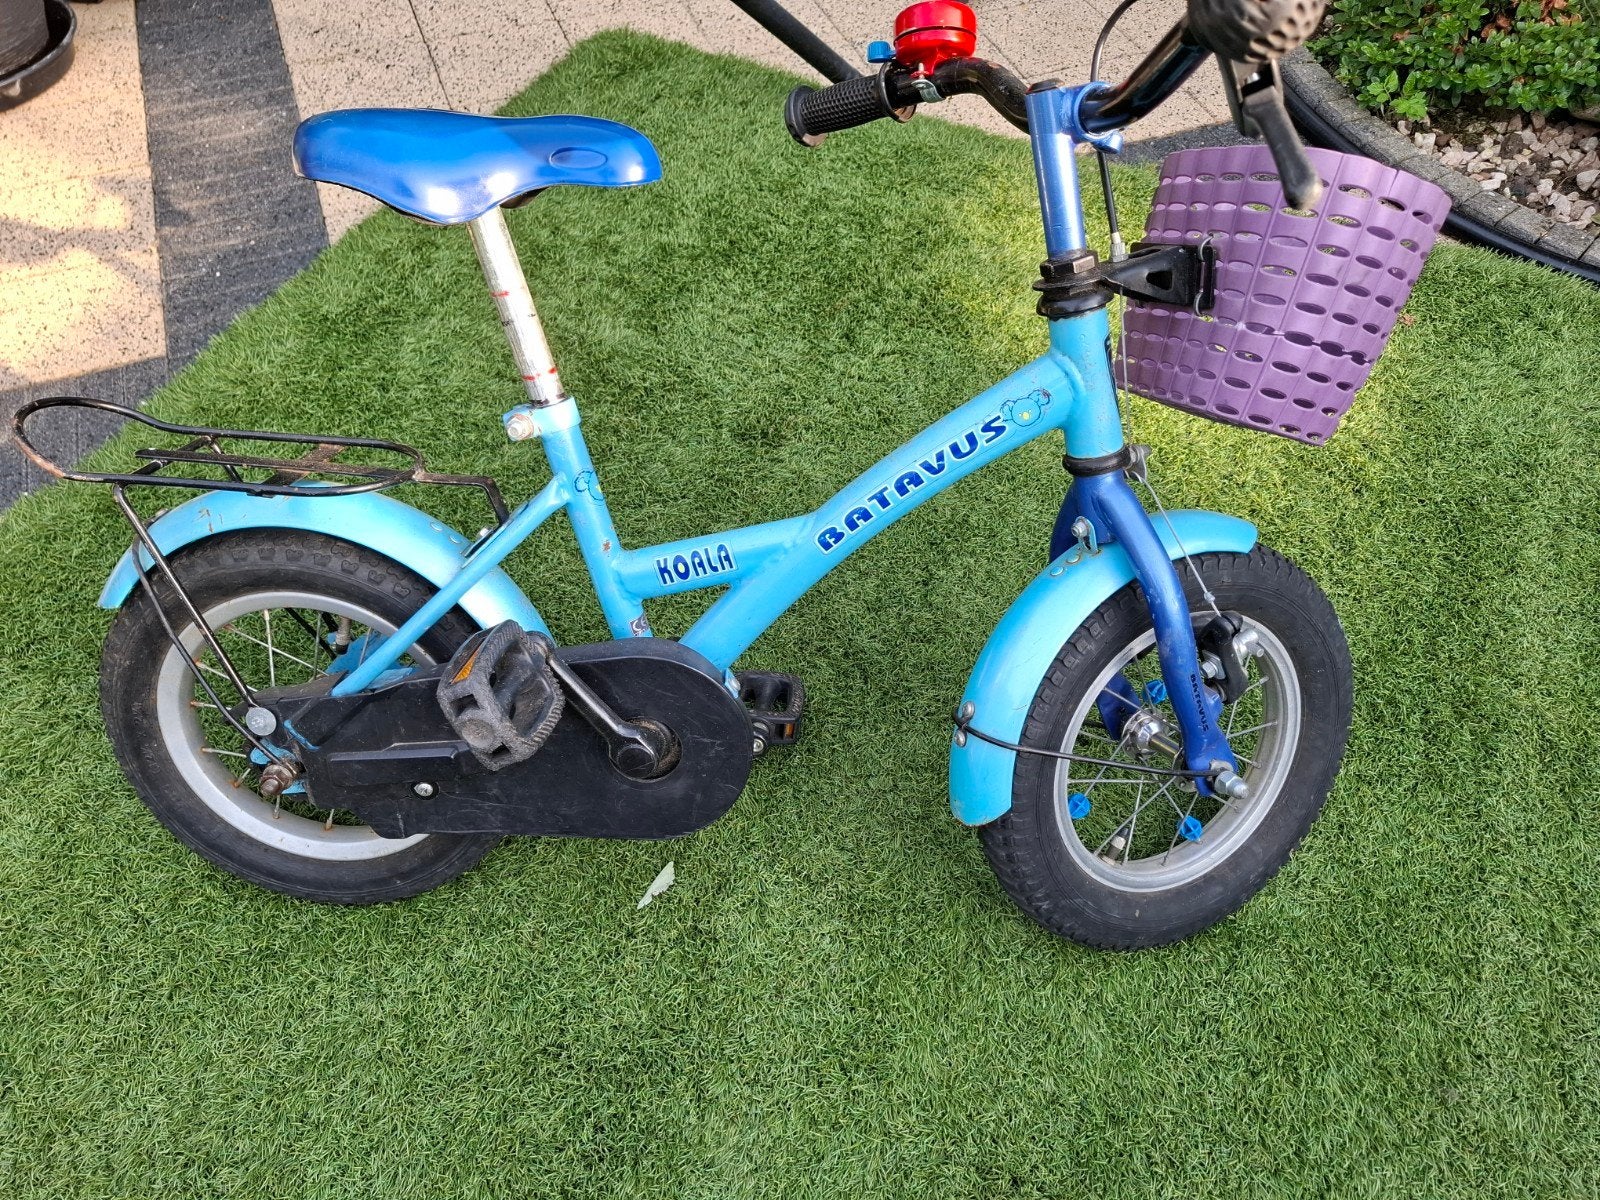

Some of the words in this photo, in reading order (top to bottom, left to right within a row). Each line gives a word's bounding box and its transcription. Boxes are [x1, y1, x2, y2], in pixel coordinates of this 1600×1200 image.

[816, 414, 1008, 553] BATAVUS
[656, 543, 734, 585] KOALA
[1190, 673, 1210, 732] BATAVUS
